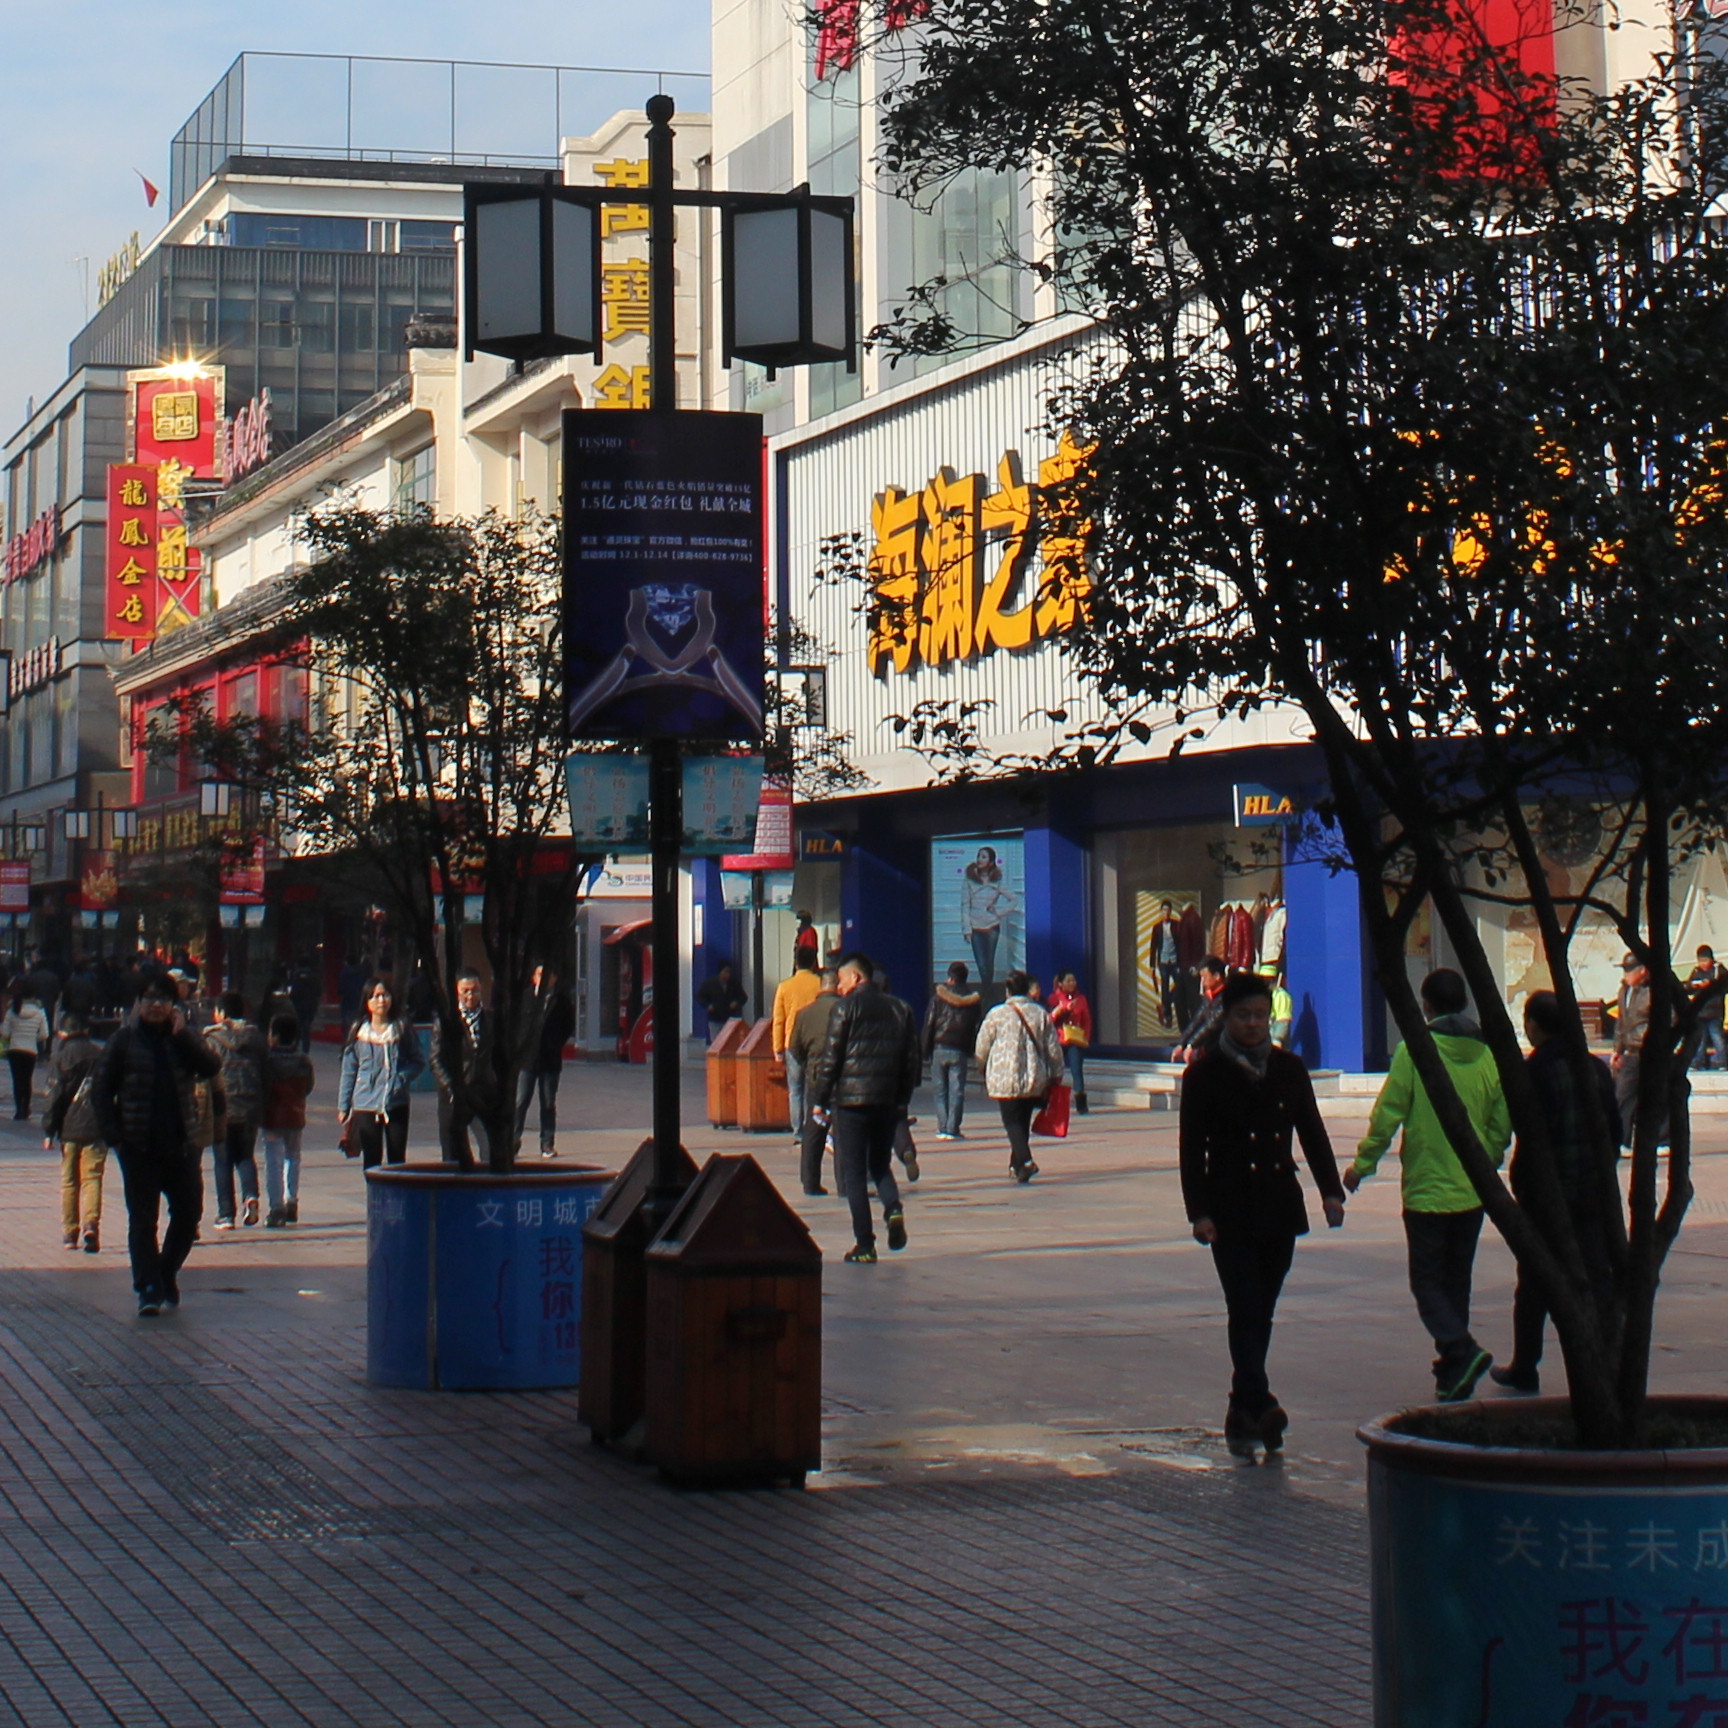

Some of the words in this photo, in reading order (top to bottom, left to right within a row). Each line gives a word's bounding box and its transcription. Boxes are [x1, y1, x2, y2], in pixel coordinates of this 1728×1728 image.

[117, 479, 150, 623] 龍鳳金店
[1243, 795, 1294, 817] HLA
[806, 837, 843, 854] HLA
